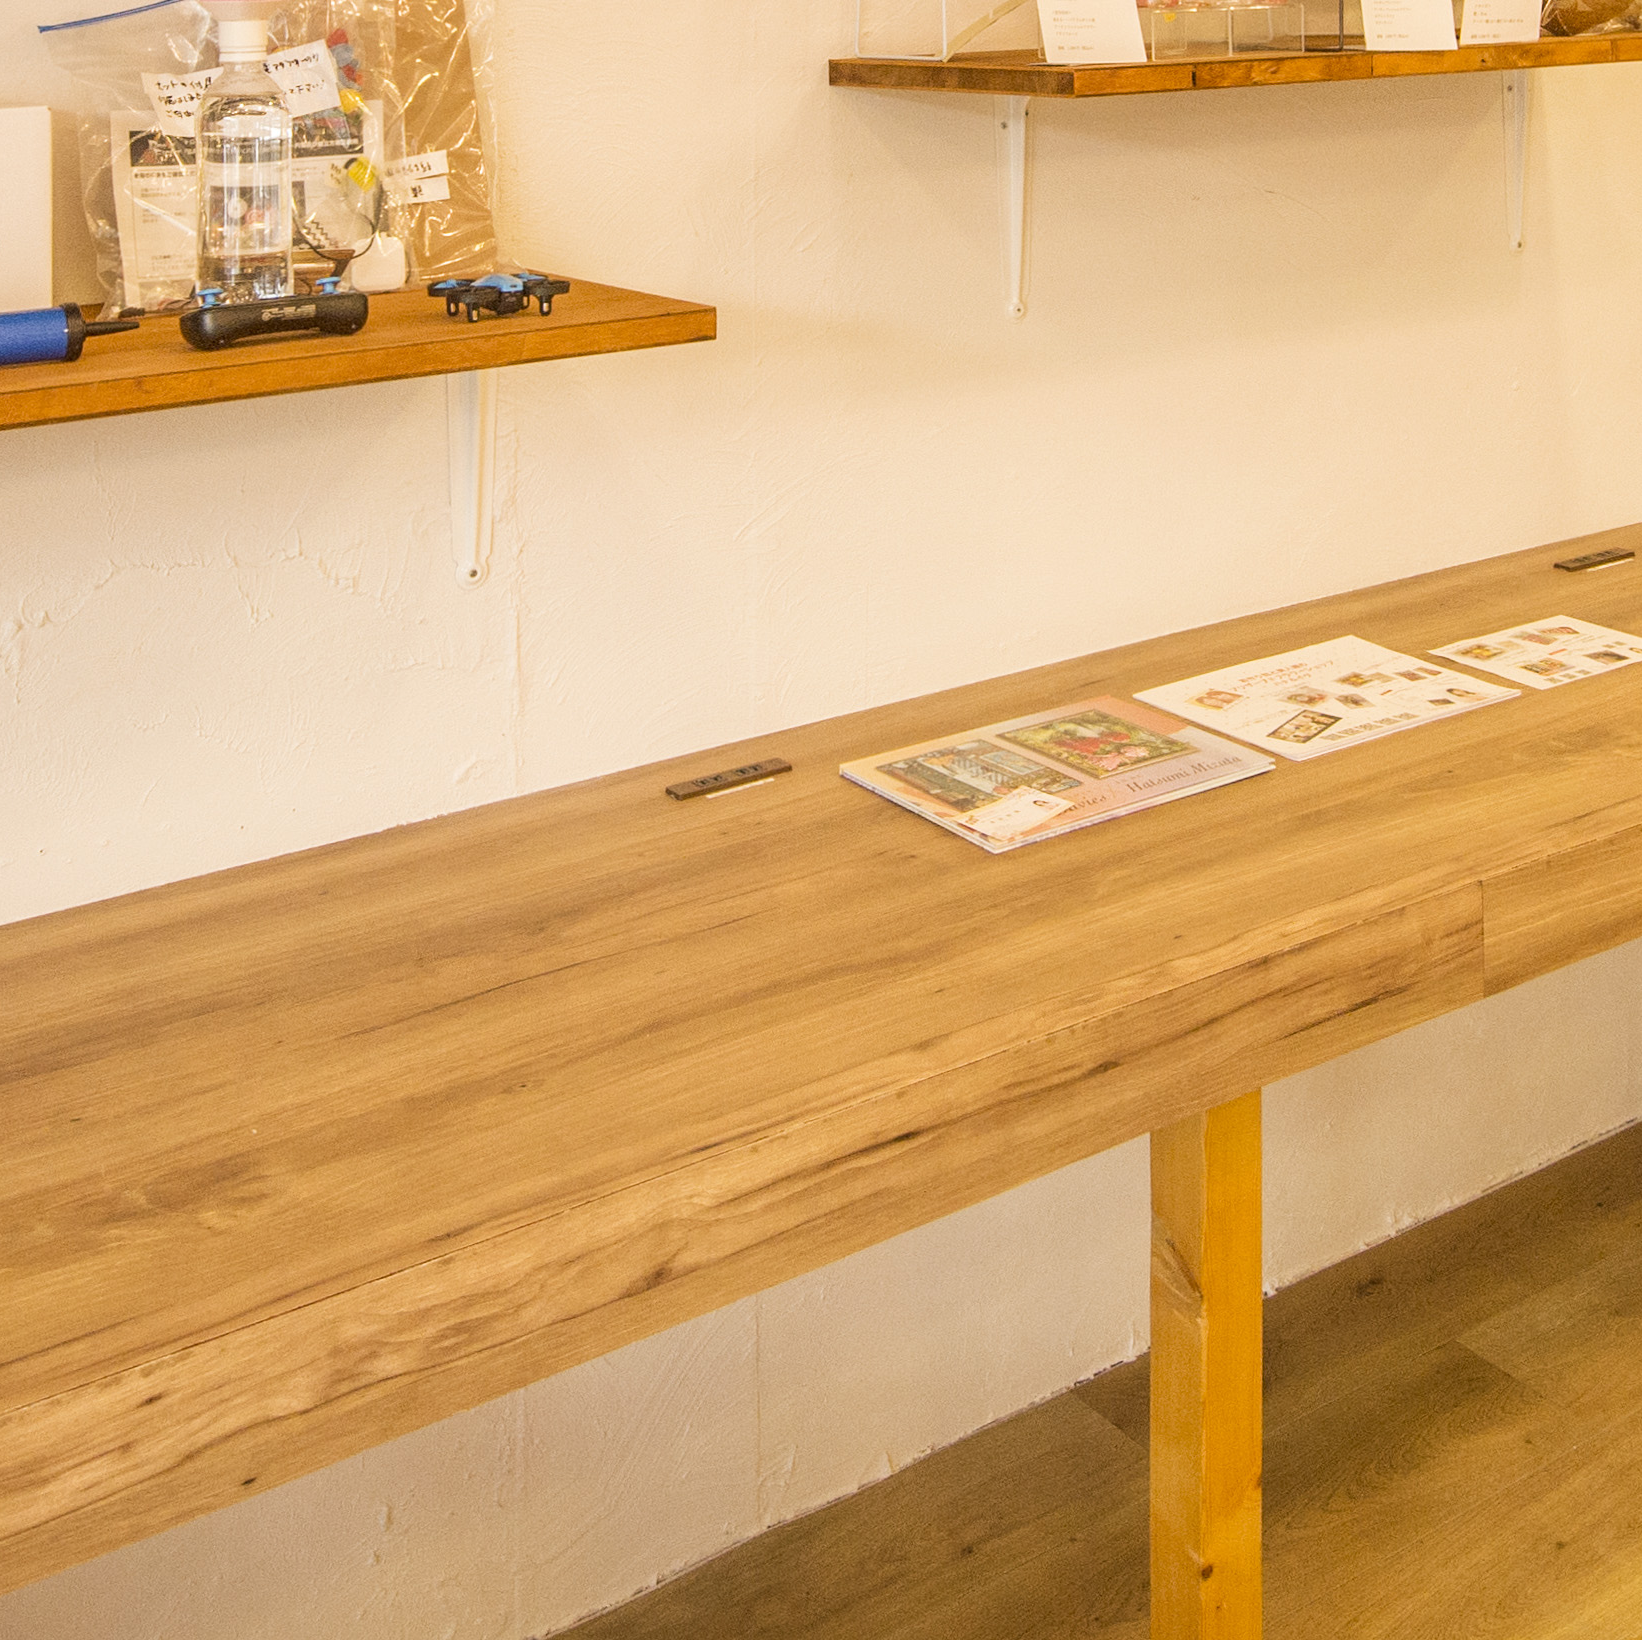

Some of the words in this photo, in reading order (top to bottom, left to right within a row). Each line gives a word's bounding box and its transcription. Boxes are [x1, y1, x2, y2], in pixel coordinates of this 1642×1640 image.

[1064, 793, 1107, 813] avies
[1126, 767, 1189, 793] Hatsumi
[1192, 754, 1243, 776] Mizuta
